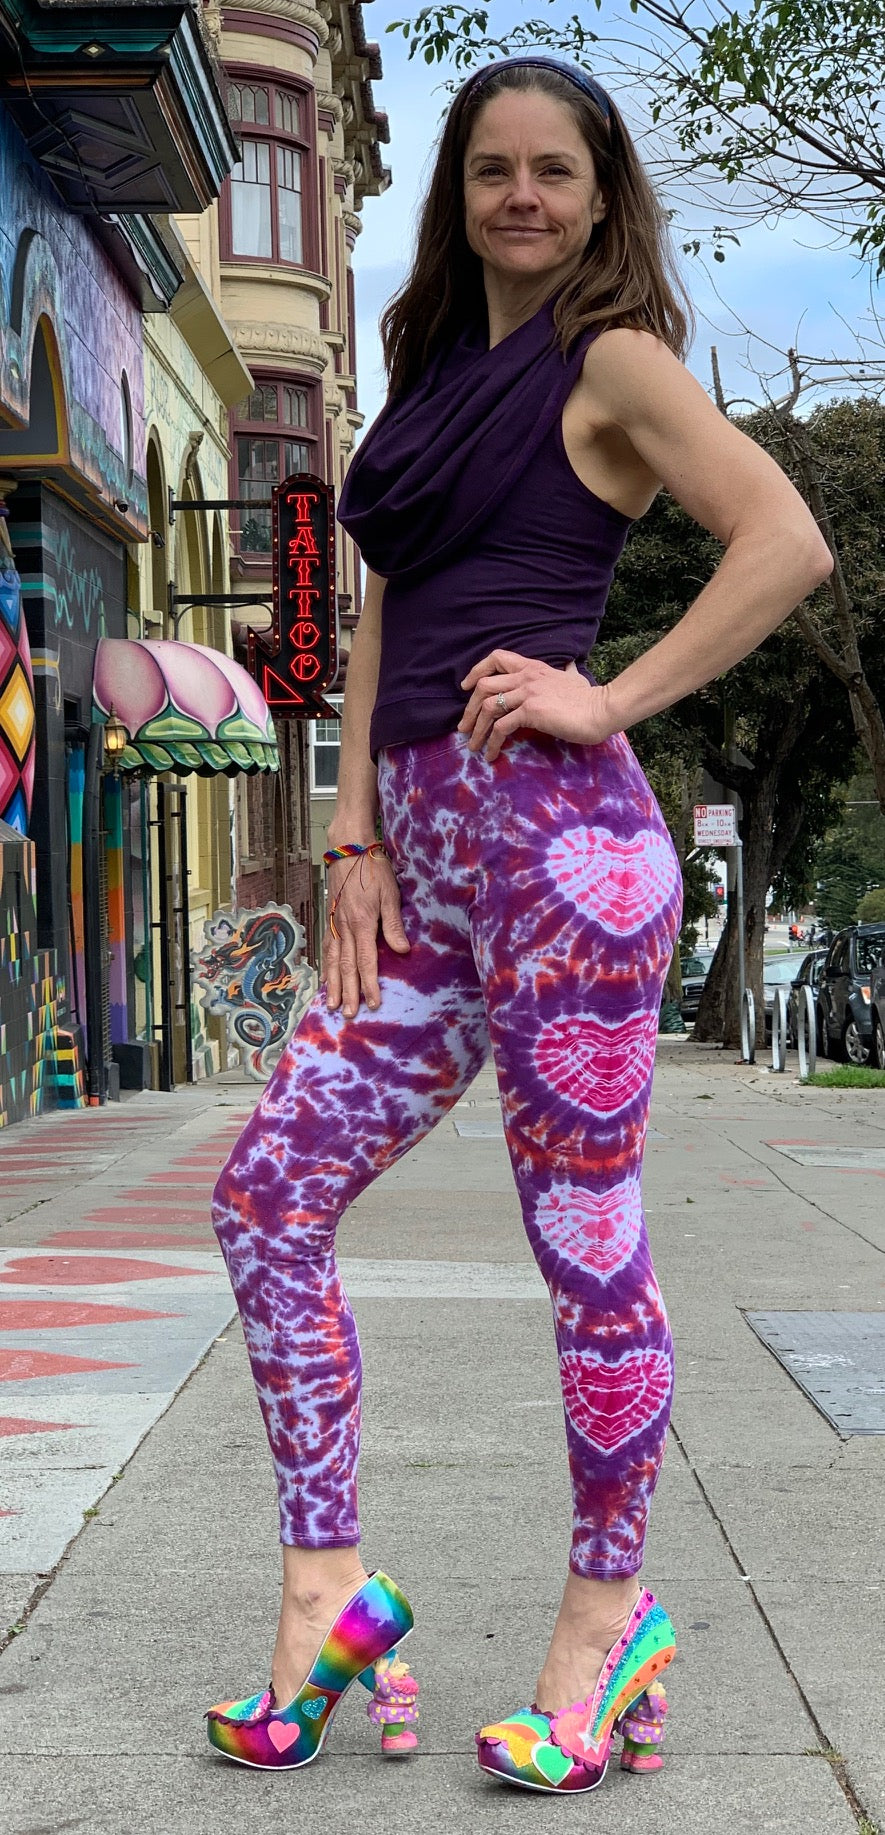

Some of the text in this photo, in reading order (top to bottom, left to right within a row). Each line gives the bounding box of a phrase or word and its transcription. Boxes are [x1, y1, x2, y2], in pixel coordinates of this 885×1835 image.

[287, 494, 320, 681] TATTOO
[695, 807, 732, 818] NO PARKING
